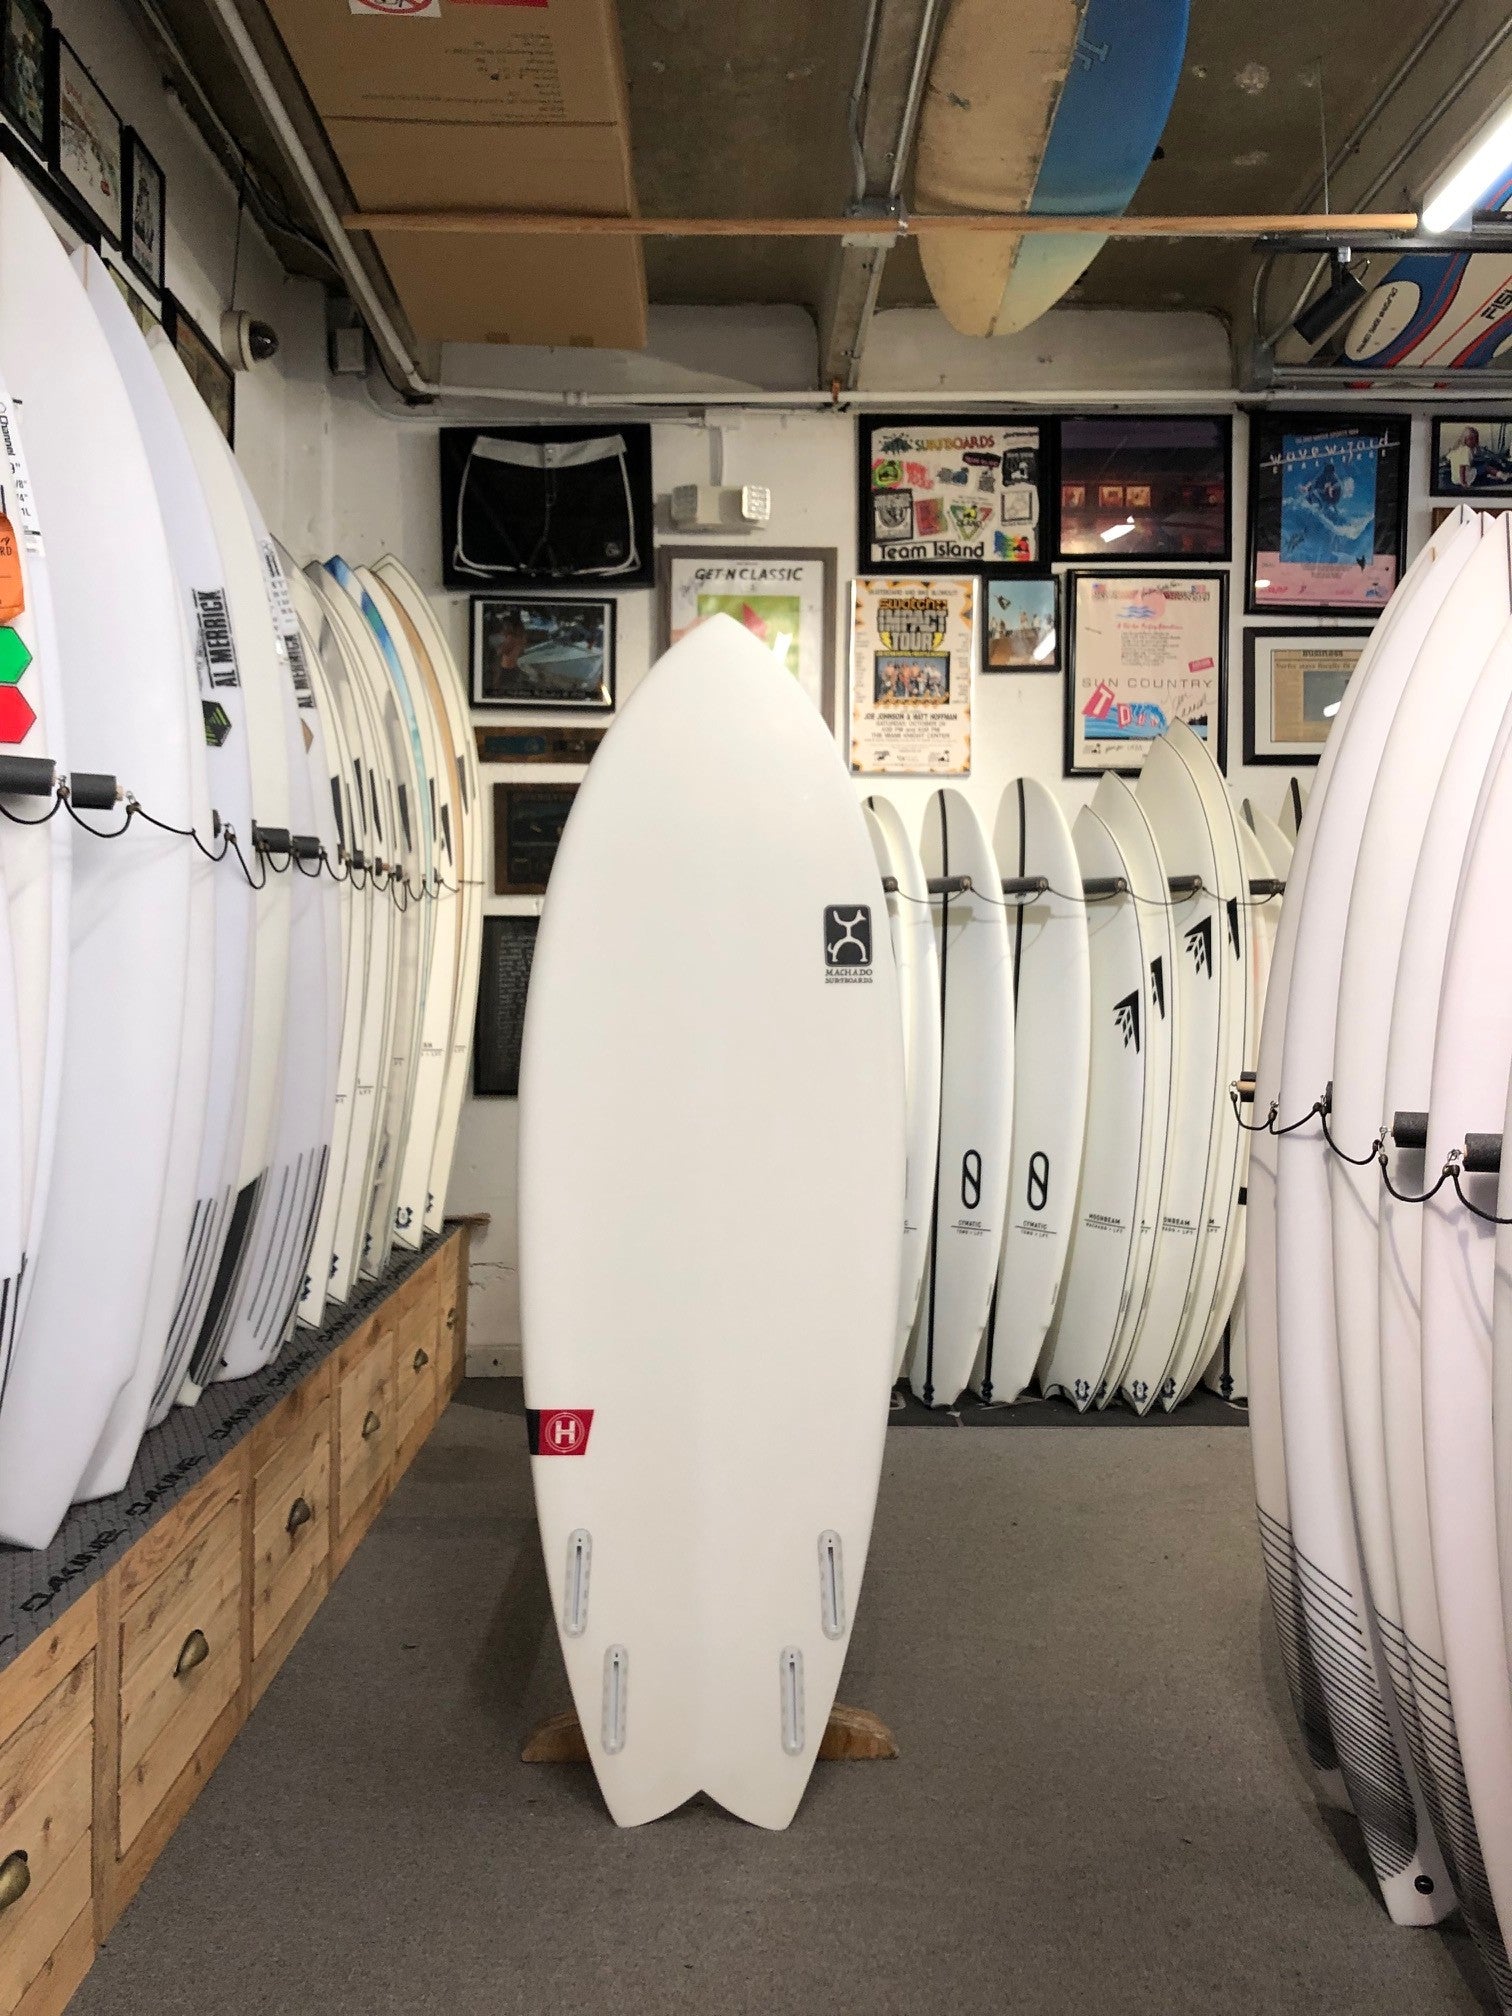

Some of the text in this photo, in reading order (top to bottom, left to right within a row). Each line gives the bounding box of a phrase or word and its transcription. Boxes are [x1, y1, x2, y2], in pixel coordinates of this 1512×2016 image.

[880, 541, 985, 561] Team Island
[197, 590, 238, 688] AL MERRICK
[891, 632, 934, 651] TOUR
[1082, 677, 1213, 688] SUN COUNTRY
[958, 1220, 982, 1228] CYMATIC
[1023, 1220, 1048, 1230] CYMATIC
[554, 1420, 576, 1444] H
